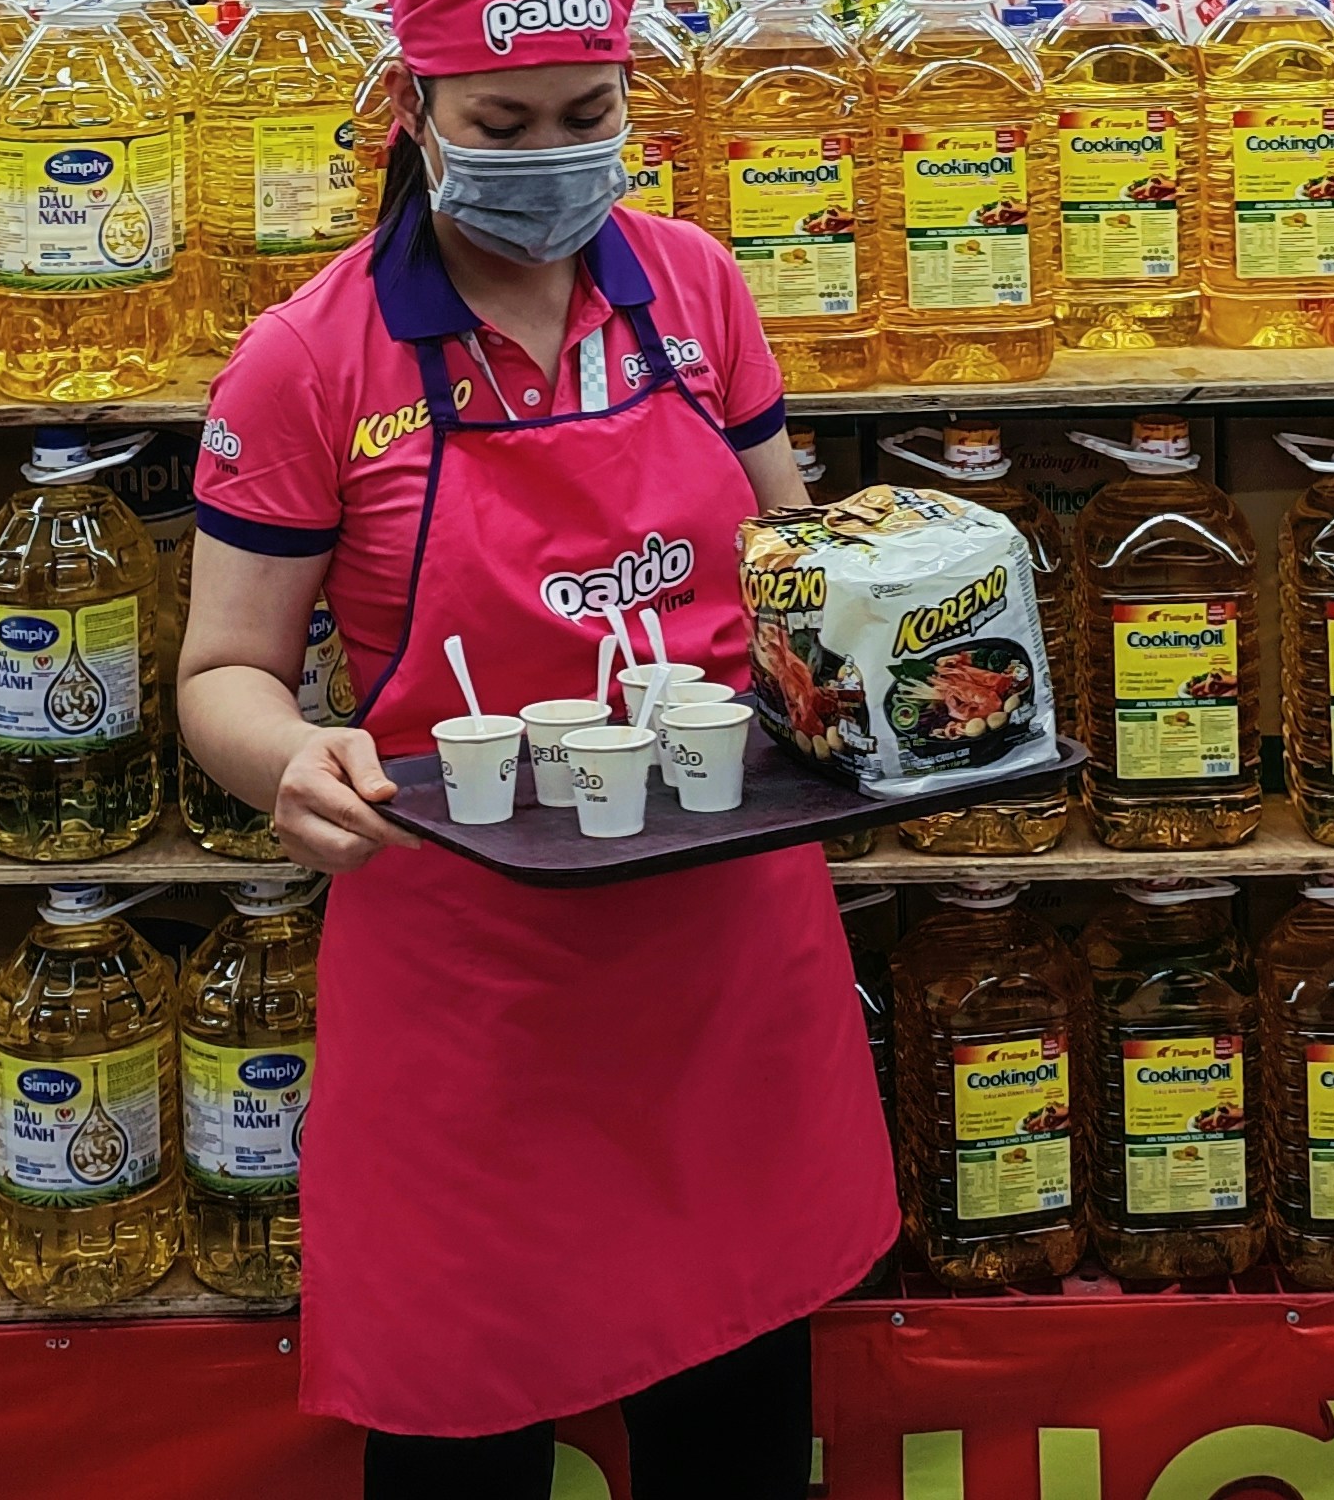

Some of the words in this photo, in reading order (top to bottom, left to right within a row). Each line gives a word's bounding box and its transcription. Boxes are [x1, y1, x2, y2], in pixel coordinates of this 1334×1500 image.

[51, 156, 109, 177] Simply
[622, 336, 703, 390] pado
[680, 362, 710, 380] Vina
[349, 376, 472, 462] KOREO
[100, 460, 194, 502] mply
[893, 565, 1008, 658] KORENO
[1, 624, 55, 644] Simply
[309, 618, 333, 638] ply
[245, 1062, 301, 1082] Simply
[22, 1076, 76, 1096] Simply
